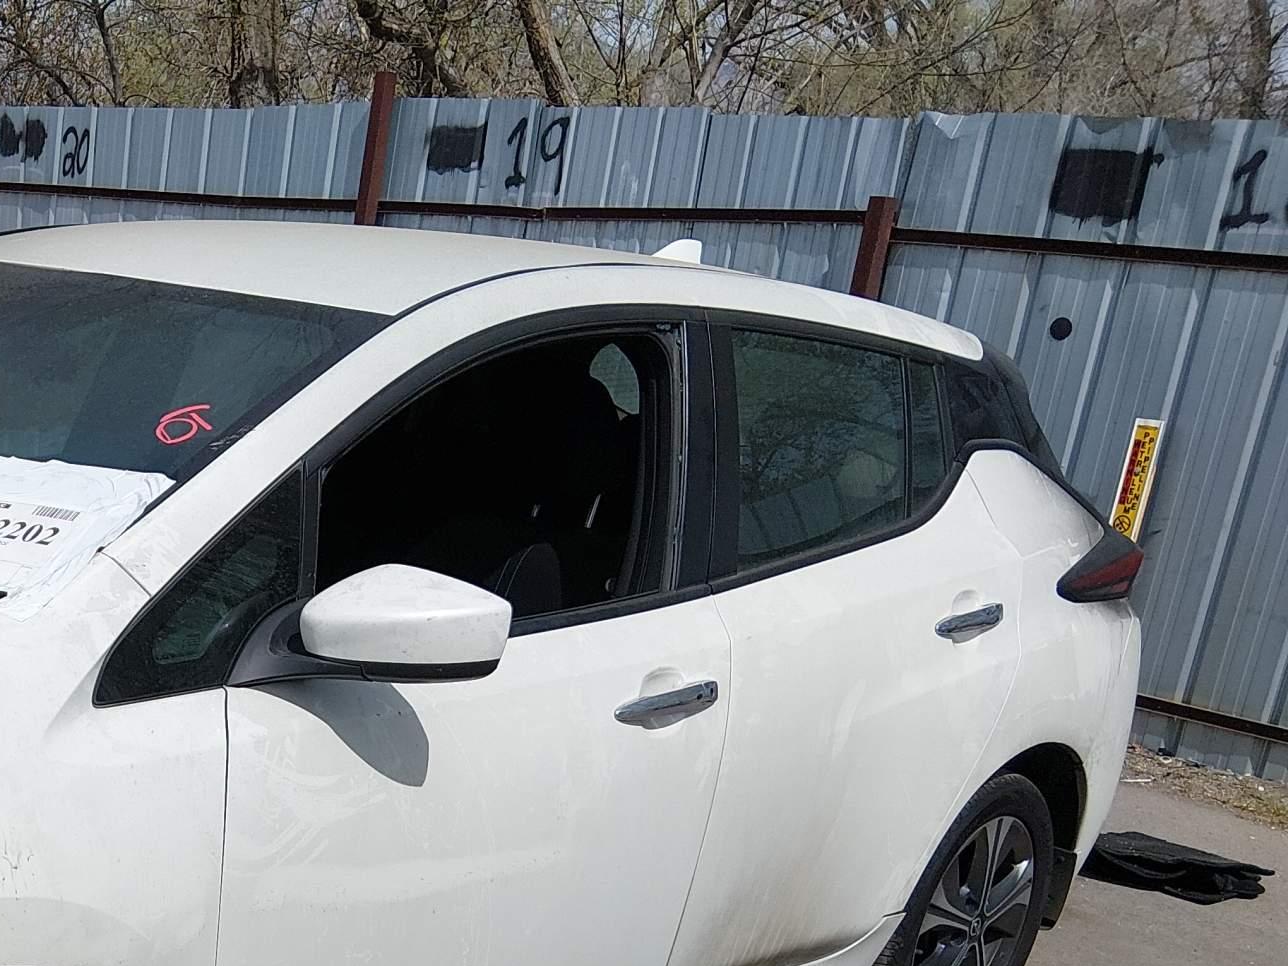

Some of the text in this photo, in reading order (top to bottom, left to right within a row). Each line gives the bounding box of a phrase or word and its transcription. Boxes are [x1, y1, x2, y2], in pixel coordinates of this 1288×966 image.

[62, 126, 91, 179] 20
[504, 116, 572, 197] 19
[1219, 149, 1288, 230] 1
